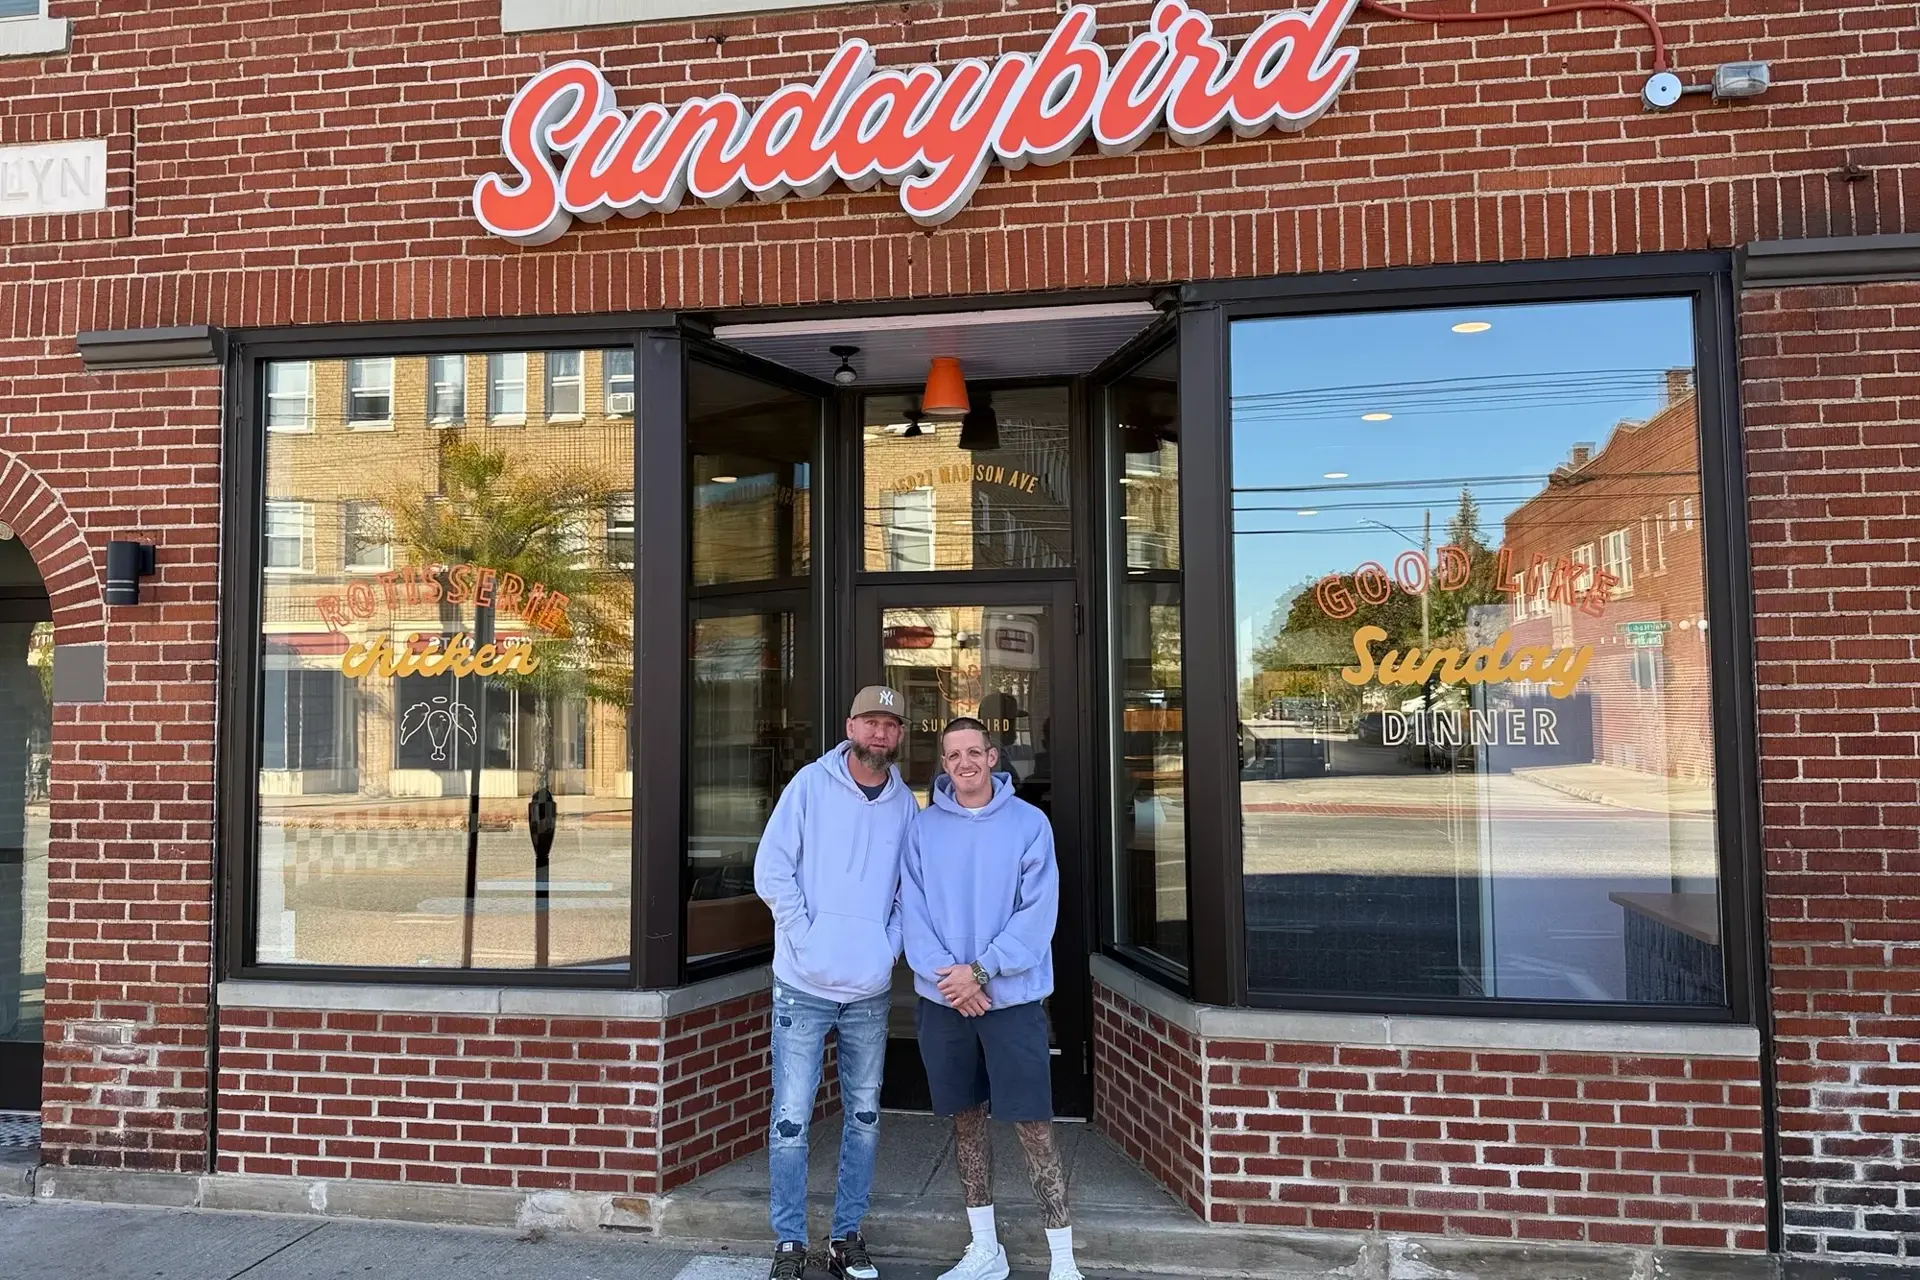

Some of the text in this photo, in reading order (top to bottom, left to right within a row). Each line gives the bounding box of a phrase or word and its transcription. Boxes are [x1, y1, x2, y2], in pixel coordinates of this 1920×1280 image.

[473, 0, 1360, 246] Sundaybird
[938, 463, 1005, 485] MADISON
[1008, 470, 1039, 494] AVE
[316, 563, 569, 634] ROTISSERIE
[1316, 545, 1620, 620] GOOD LIKE
[341, 632, 541, 678] chicken
[1341, 625, 1595, 699] Sunday
[1382, 708, 1561, 747] DINNER
